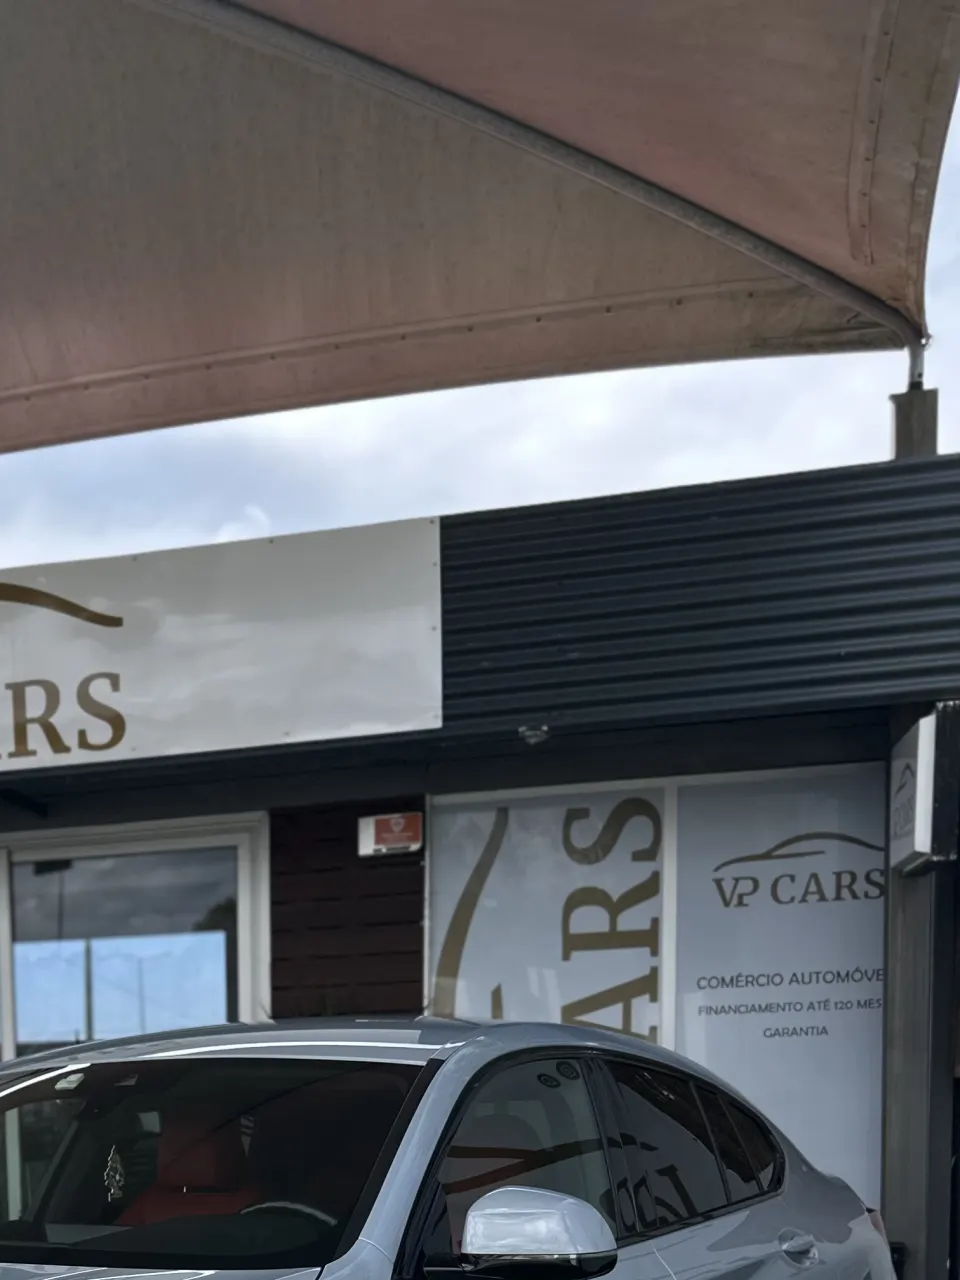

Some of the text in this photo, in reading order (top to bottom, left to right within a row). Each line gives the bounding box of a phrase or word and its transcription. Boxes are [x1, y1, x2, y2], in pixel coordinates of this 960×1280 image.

[712, 868, 886, 908] VP CARS
[696, 972, 784, 990] COMÉRCIO
[697, 997, 883, 1017] FINANCIAMENTO ATÉ 120 MES
[763, 1025, 829, 1039] GARANTIA
